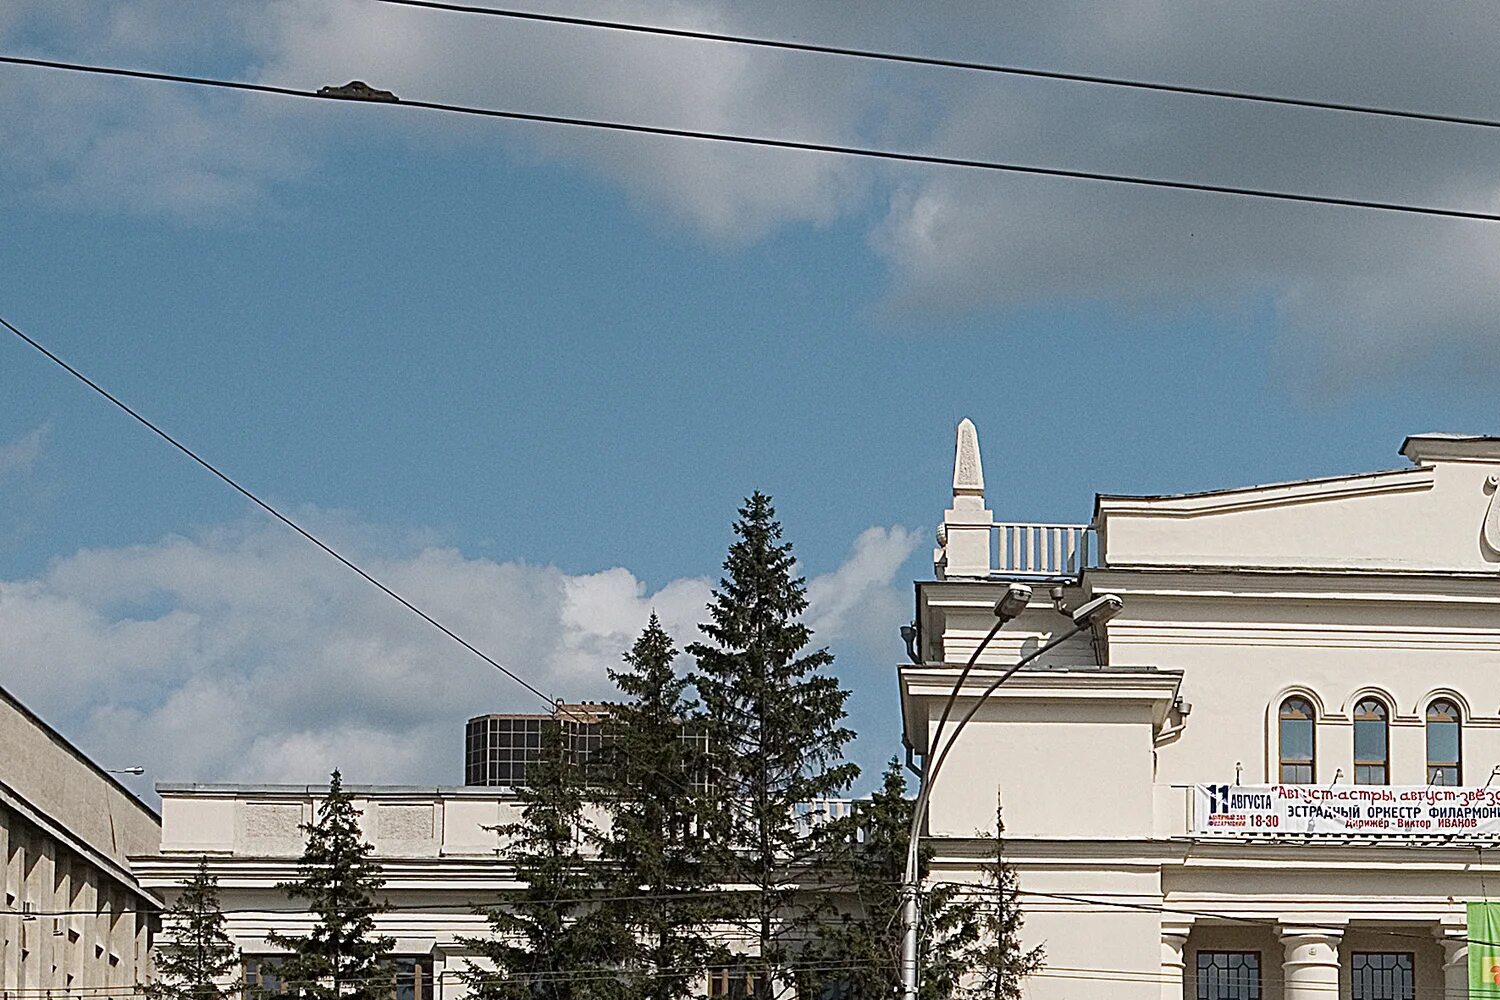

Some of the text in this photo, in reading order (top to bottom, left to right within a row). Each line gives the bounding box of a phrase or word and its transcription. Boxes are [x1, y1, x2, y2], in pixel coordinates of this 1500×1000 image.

[1206, 785, 1229, 814] 11
[1231, 794, 1272, 810] АВГУСТА
[1288, 804, 1360, 819] ЭСТРАДНЫЙ
[1367, 806, 1422, 818] ОРКЕСТР
[1250, 815, 1279, 828] 18-30
[1398, 818, 1432, 829] Виктор
[1437, 818, 1479, 828] ИВАНОВ
